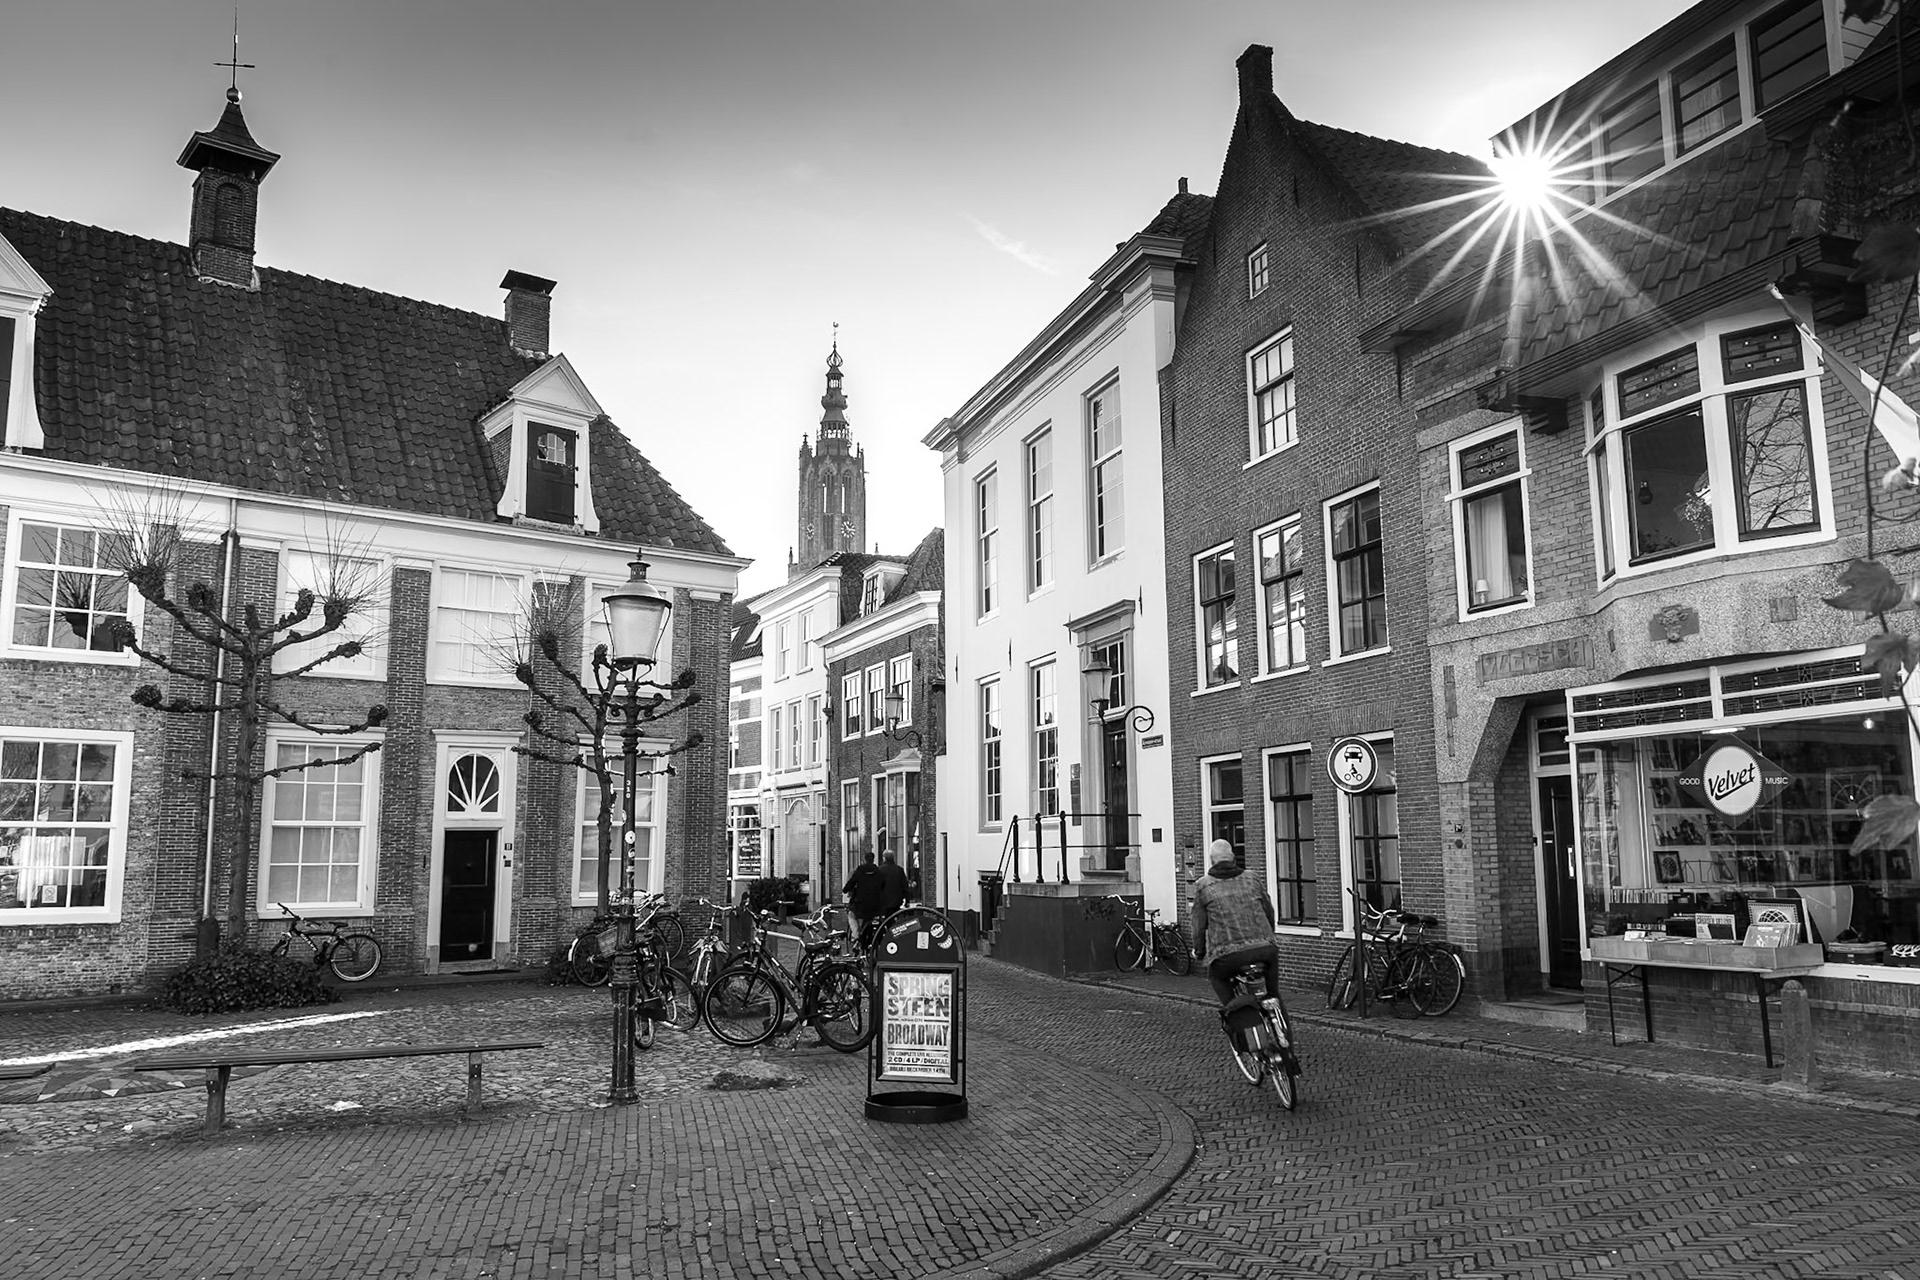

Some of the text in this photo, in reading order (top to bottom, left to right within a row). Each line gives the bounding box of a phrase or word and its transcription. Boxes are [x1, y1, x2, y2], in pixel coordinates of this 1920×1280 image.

[1679, 762, 1789, 798] GOOD Velvet MUSIC
[888, 977, 949, 997] SPRING
[888, 997, 949, 1017] STEEN
[888, 1024, 949, 1046] BROADWAY
